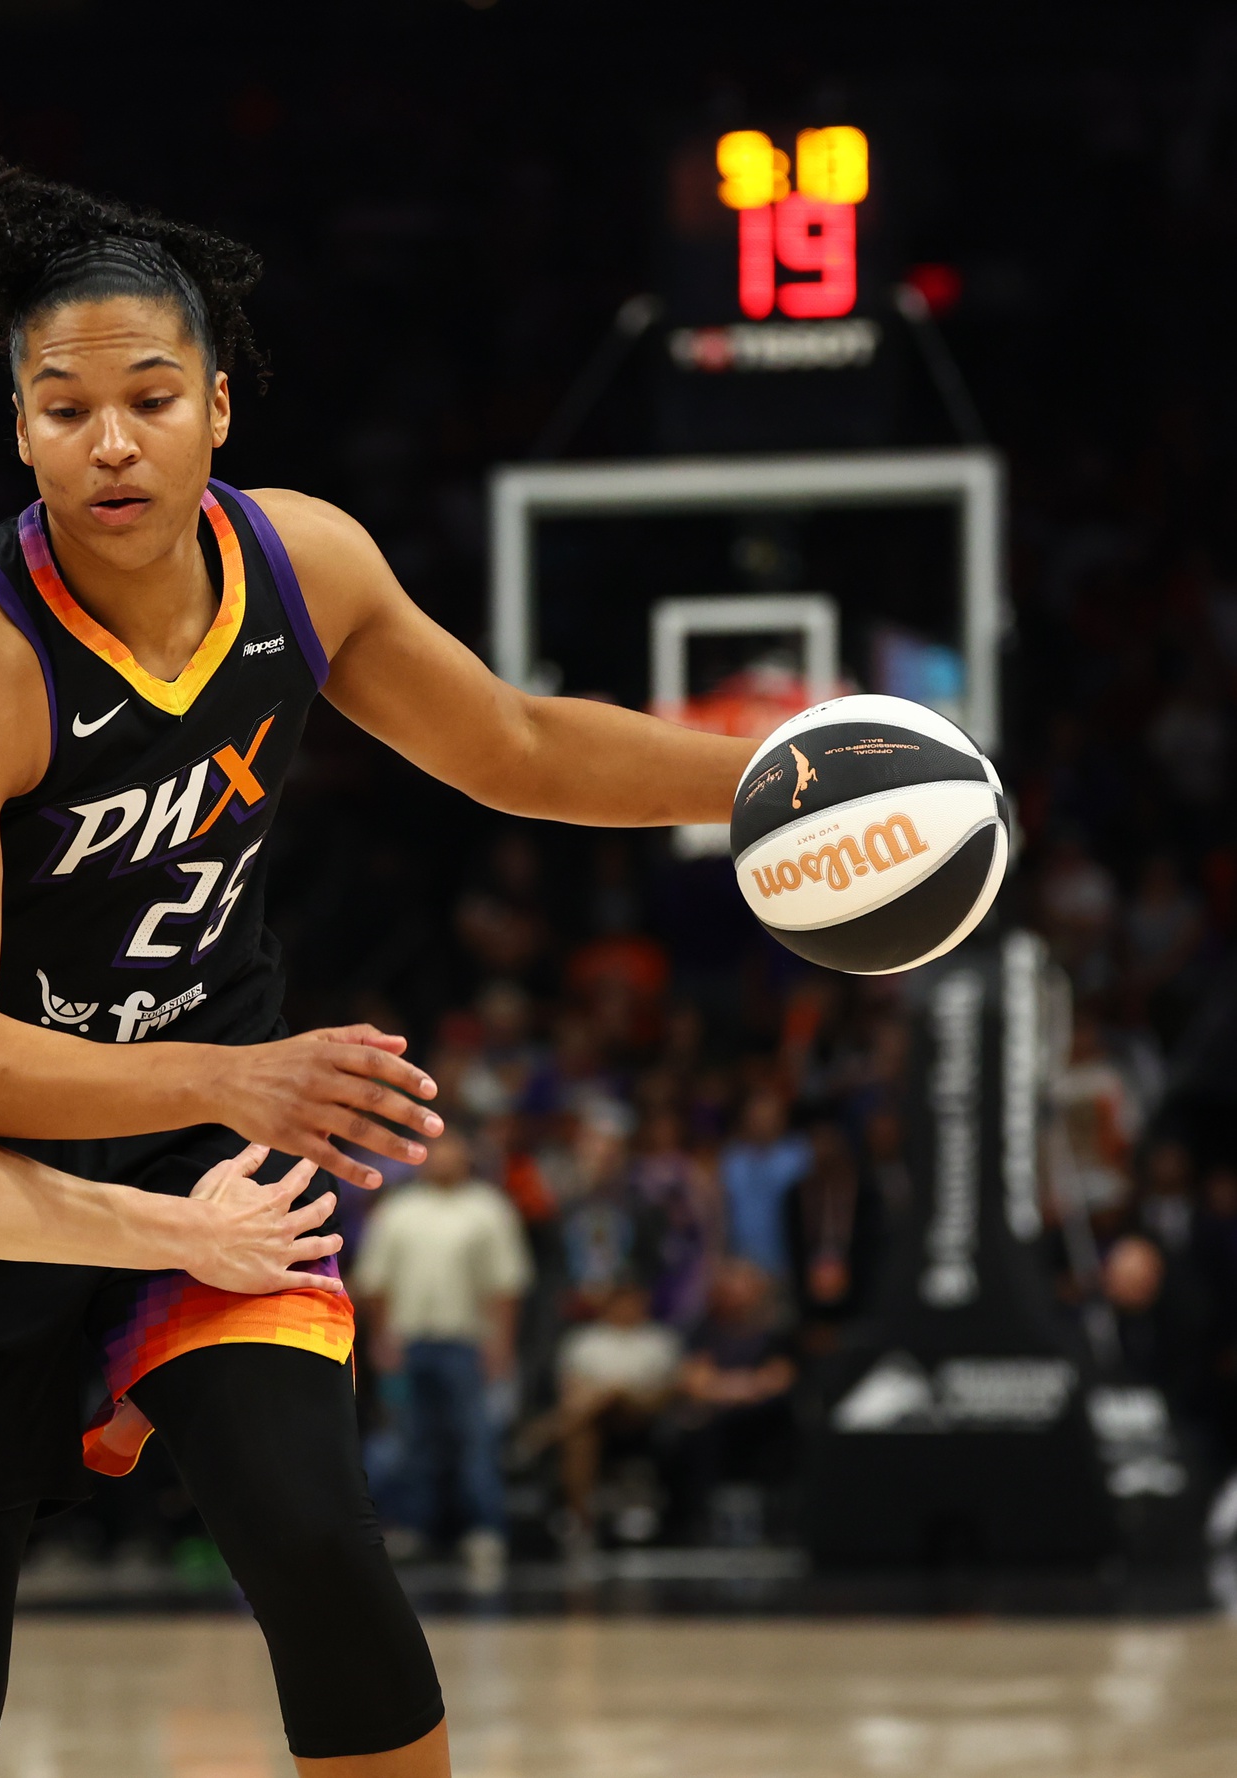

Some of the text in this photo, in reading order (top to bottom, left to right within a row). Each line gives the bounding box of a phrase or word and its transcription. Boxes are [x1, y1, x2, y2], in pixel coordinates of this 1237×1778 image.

[738, 191, 857, 320] 19
[824, 747, 844, 755] CUP
[48, 714, 275, 877] PHX
[796, 824, 840, 846] EVO NXT
[751, 812, 930, 899] Wilson
[122, 838, 264, 961] 25
[141, 986, 202, 1020] FOOD STORES
